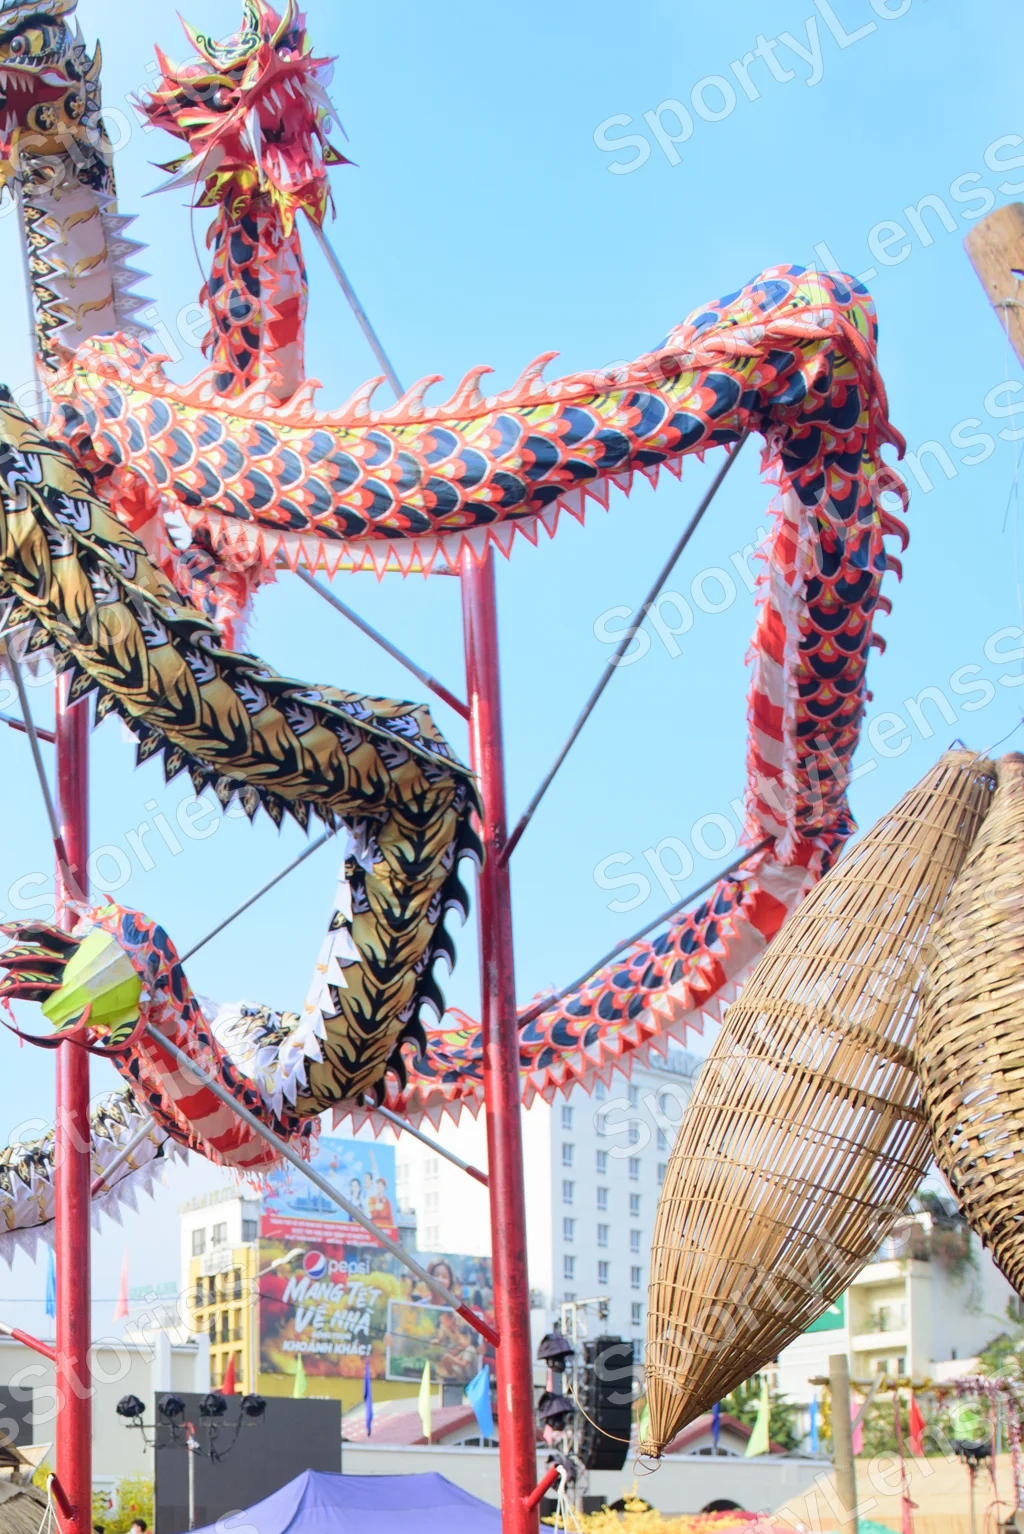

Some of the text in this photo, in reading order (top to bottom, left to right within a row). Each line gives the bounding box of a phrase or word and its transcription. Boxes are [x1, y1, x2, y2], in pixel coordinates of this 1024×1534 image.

[328, 1259, 370, 1277] pepsi
[282, 1277, 383, 1309] MANG TẾT
[294, 1303, 375, 1336] VỀ NHÀ
